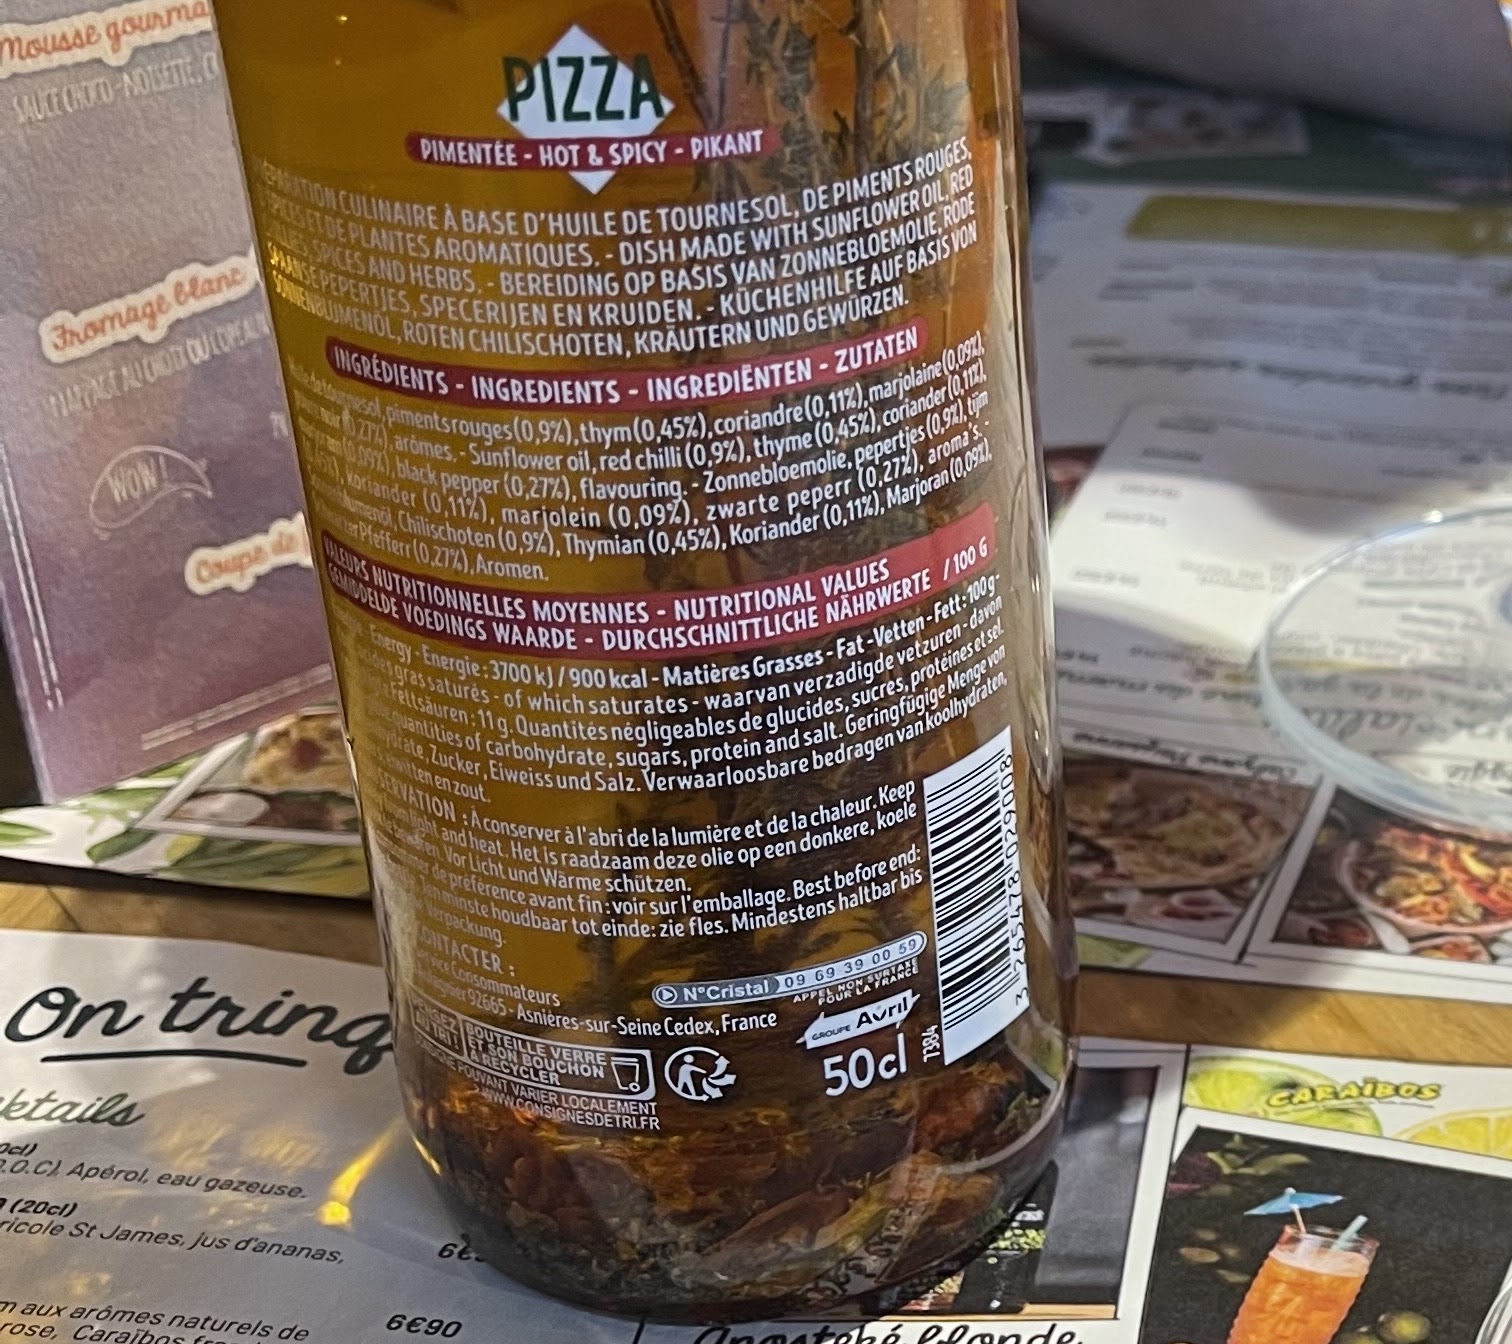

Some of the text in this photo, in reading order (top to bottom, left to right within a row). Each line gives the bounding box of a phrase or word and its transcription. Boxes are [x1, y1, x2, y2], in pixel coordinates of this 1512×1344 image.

[502, 55, 665, 124] PIZZA
[421, 130, 764, 167] PIMENTÉE HOT SPICY PIKANT
[339, 192, 438, 230] CULINAIRE
[462, 210, 519, 235] BASE
[623, 209, 651, 235] DE
[803, 187, 829, 212] DE
[834, 162, 913, 205] PIMENTS
[619, 192, 921, 267] DISH MADE WITH SUNFLOWER
[500, 260, 775, 298] BEREIDING BASIS VAN
[720, 269, 867, 319] KÜCHENHILFE
[52, 296, 168, 351] Fromage
[634, 312, 800, 355] KRÄUTERN UND
[333, 345, 449, 396] INGRÉDIENTS
[471, 375, 621, 405] INGREDIENTS
[648, 356, 812, 403] INGREDIËNTEN
[835, 326, 919, 374] ZUTATEN
[501, 506, 601, 533] marjolein
[373, 557, 890, 625] NUTRITIONNELLES MOYENNES NUTRITIONAL VALUES
[402, 600, 487, 642] VOEDINGS
[492, 622, 578, 651] WAARDE
[601, 607, 820, 652] DURCHSCHNITTLICHE
[825, 567, 932, 625] NÄHRWERTE
[569, 647, 825, 690] 900 kcal Matières Grasses
[589, 691, 689, 714] saturates
[793, 857, 887, 901] Best before
[5, 986, 144, 1043] On
[721, 1012, 777, 1034] France
[550, 1041, 608, 1066] VERRE
[824, 1032, 909, 1098] 50cl
[1267, 1077, 1442, 1107] CARAÏBOS
[157, 1172, 202, 1189] eau
[70, 1305, 463, 1342] arômes naturels de 6€90
